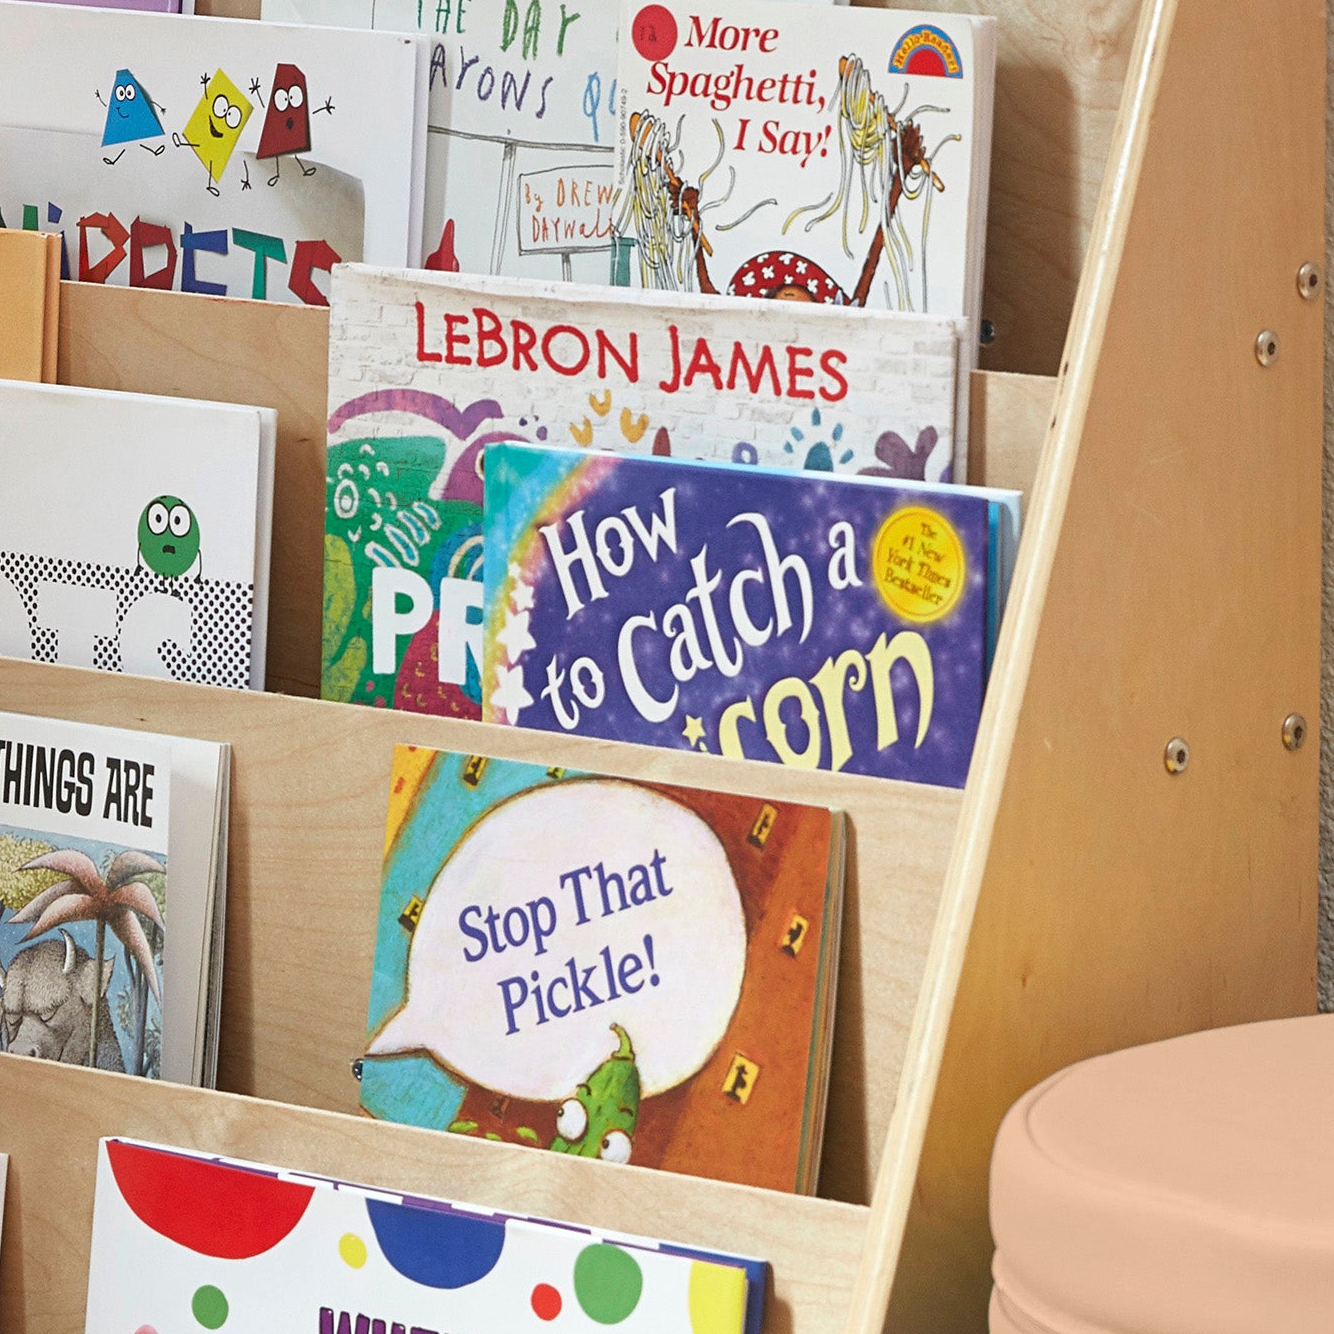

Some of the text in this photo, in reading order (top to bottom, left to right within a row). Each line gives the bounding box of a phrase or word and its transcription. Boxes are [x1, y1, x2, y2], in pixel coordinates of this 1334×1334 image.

[683, 15, 780, 54] More
[646, 61, 827, 113] Spaghetti,
[732, 118, 833, 169] I Say!
[556, 176, 614, 208] DREW
[660, 323, 850, 403] JAMES
[538, 486, 679, 624] How
[540, 510, 864, 731] to Catch a
[103, 756, 156, 830] ARE
[457, 847, 674, 963] Stop That
[497, 933, 662, 1037] Pickle!
